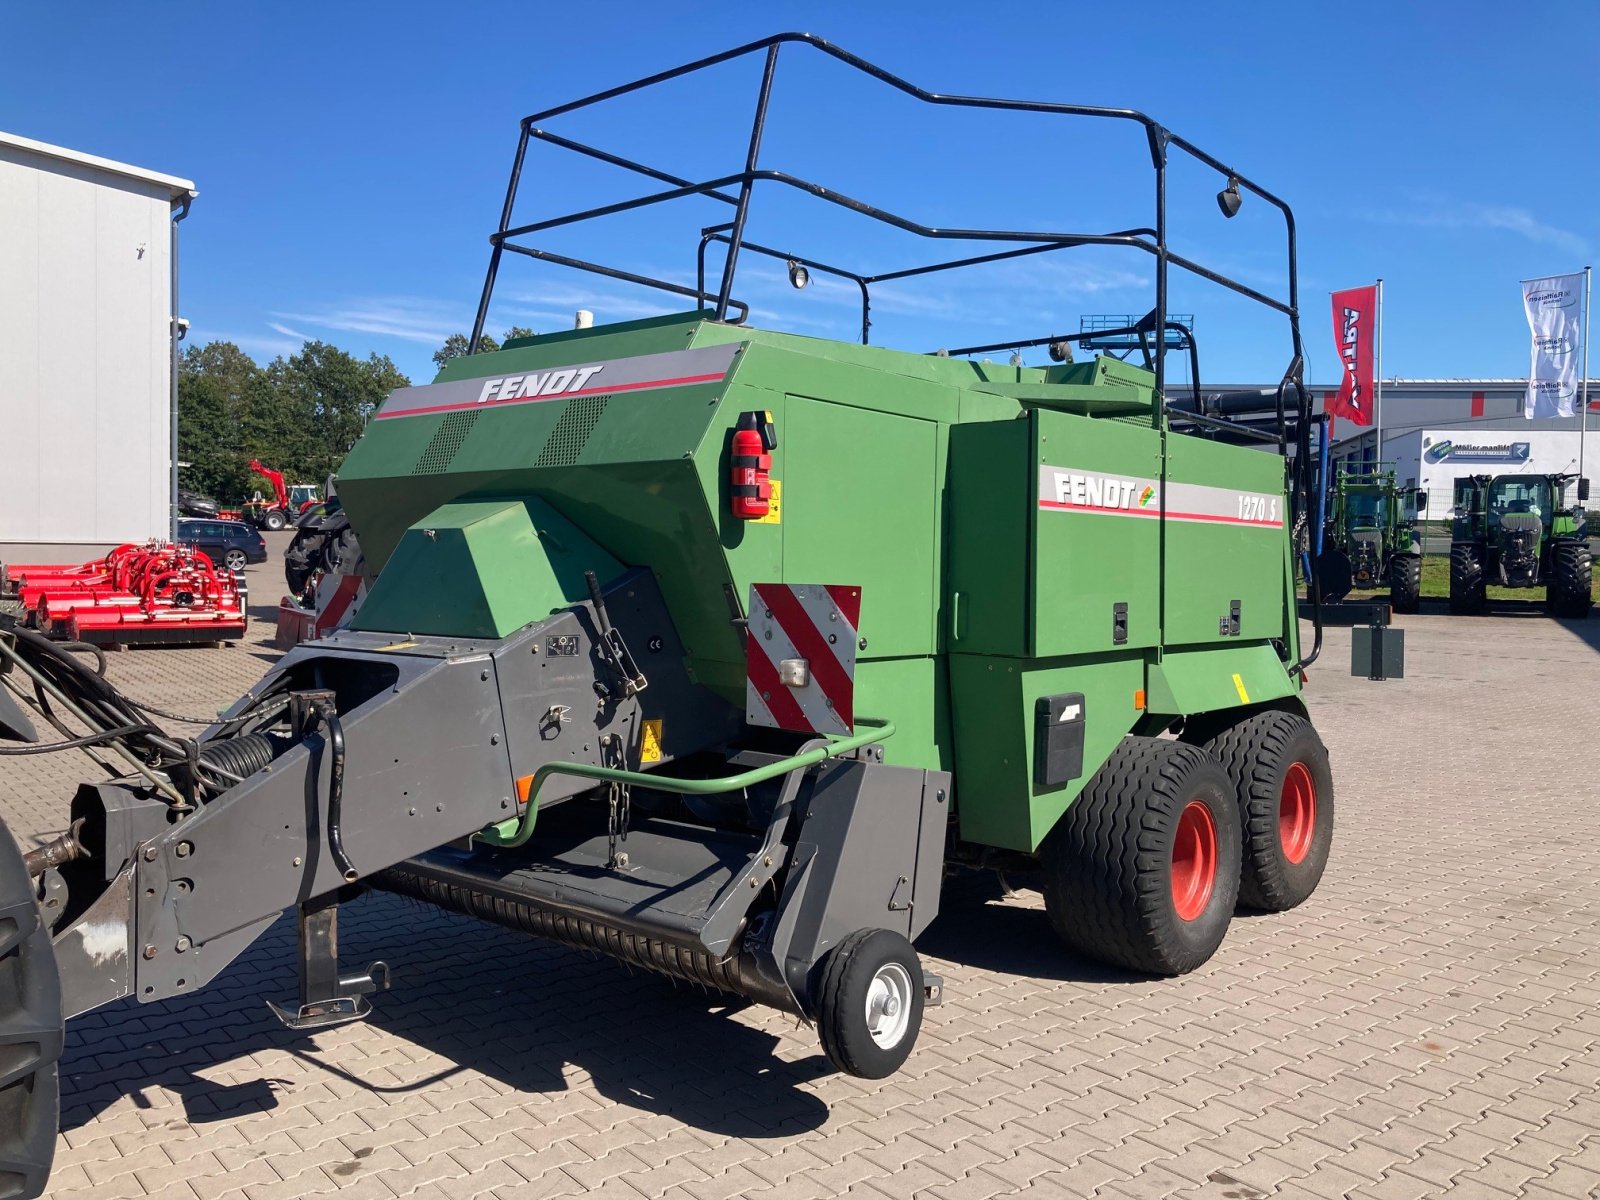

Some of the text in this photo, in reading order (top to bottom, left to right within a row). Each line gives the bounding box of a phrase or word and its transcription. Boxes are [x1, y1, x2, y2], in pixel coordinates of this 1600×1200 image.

[477, 365, 605, 403] FENDT
[1053, 472, 1136, 510] FENDT
[1238, 495, 1277, 522] 1270 S
